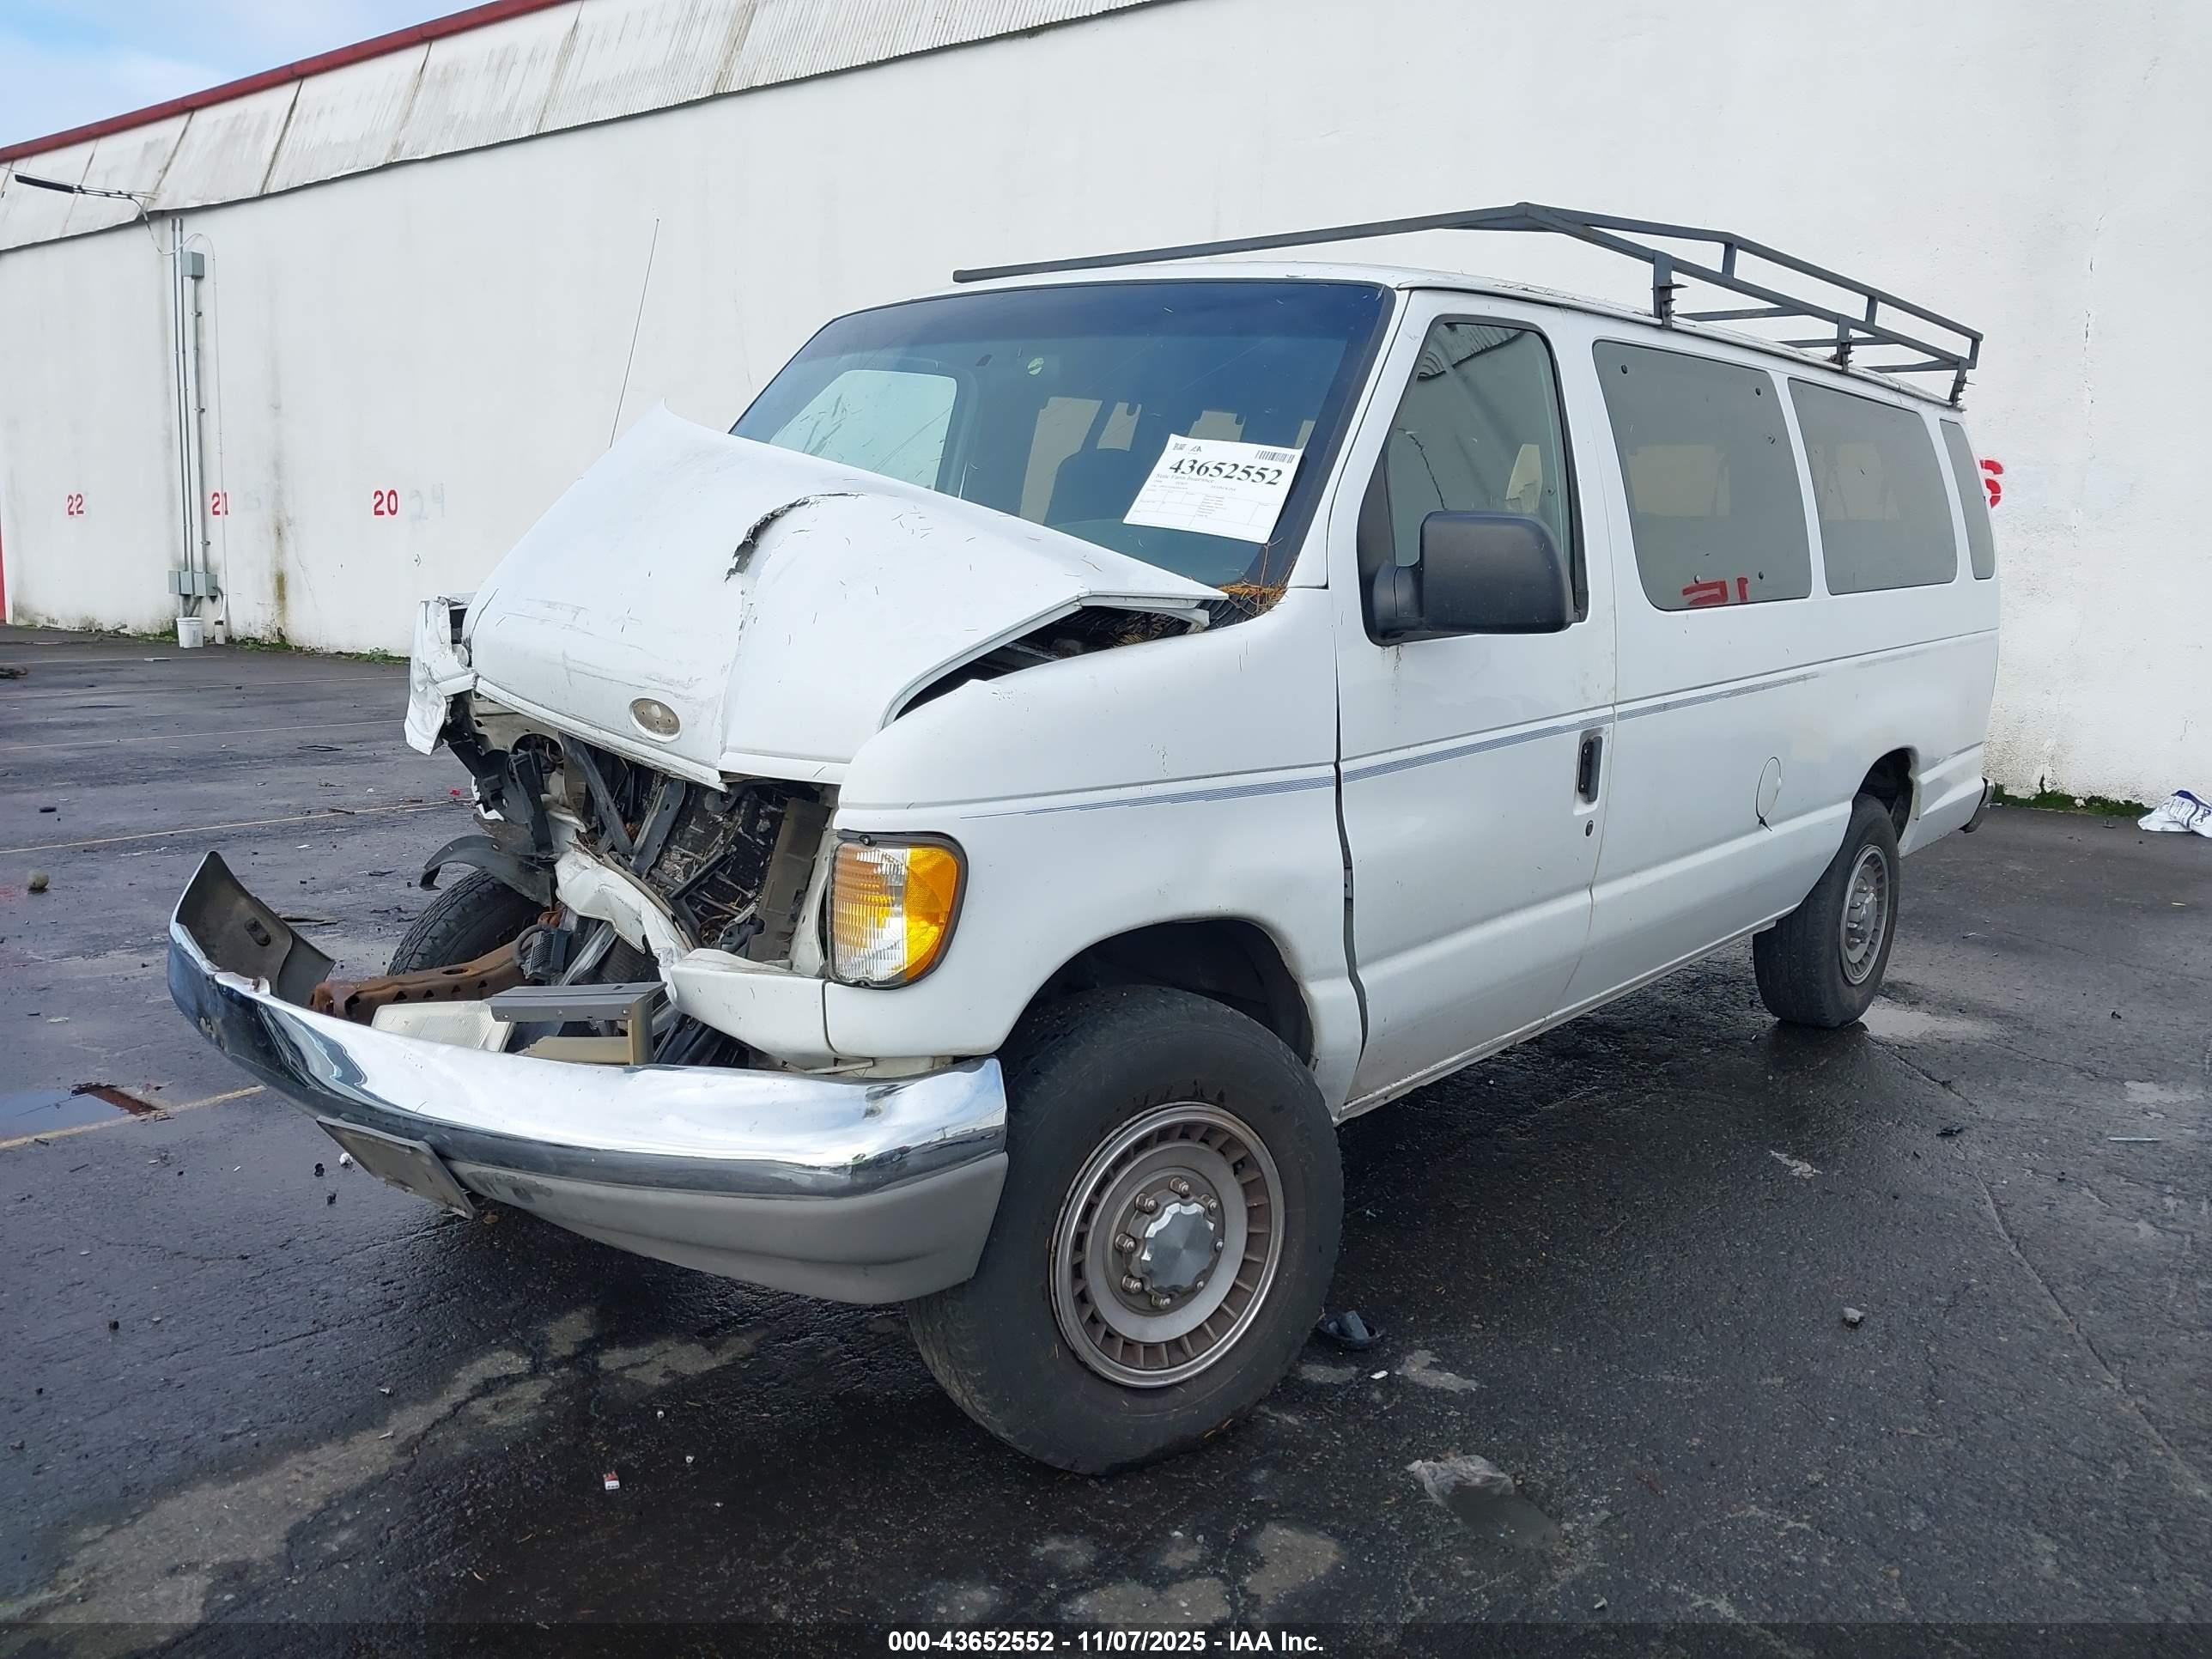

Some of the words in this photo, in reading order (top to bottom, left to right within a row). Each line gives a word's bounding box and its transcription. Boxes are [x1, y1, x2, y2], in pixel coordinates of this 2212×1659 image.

[1169, 458, 1283, 486] 43652552
[67, 493, 84, 515] 22
[211, 492, 228, 515] 21
[373, 489, 398, 515] 20
